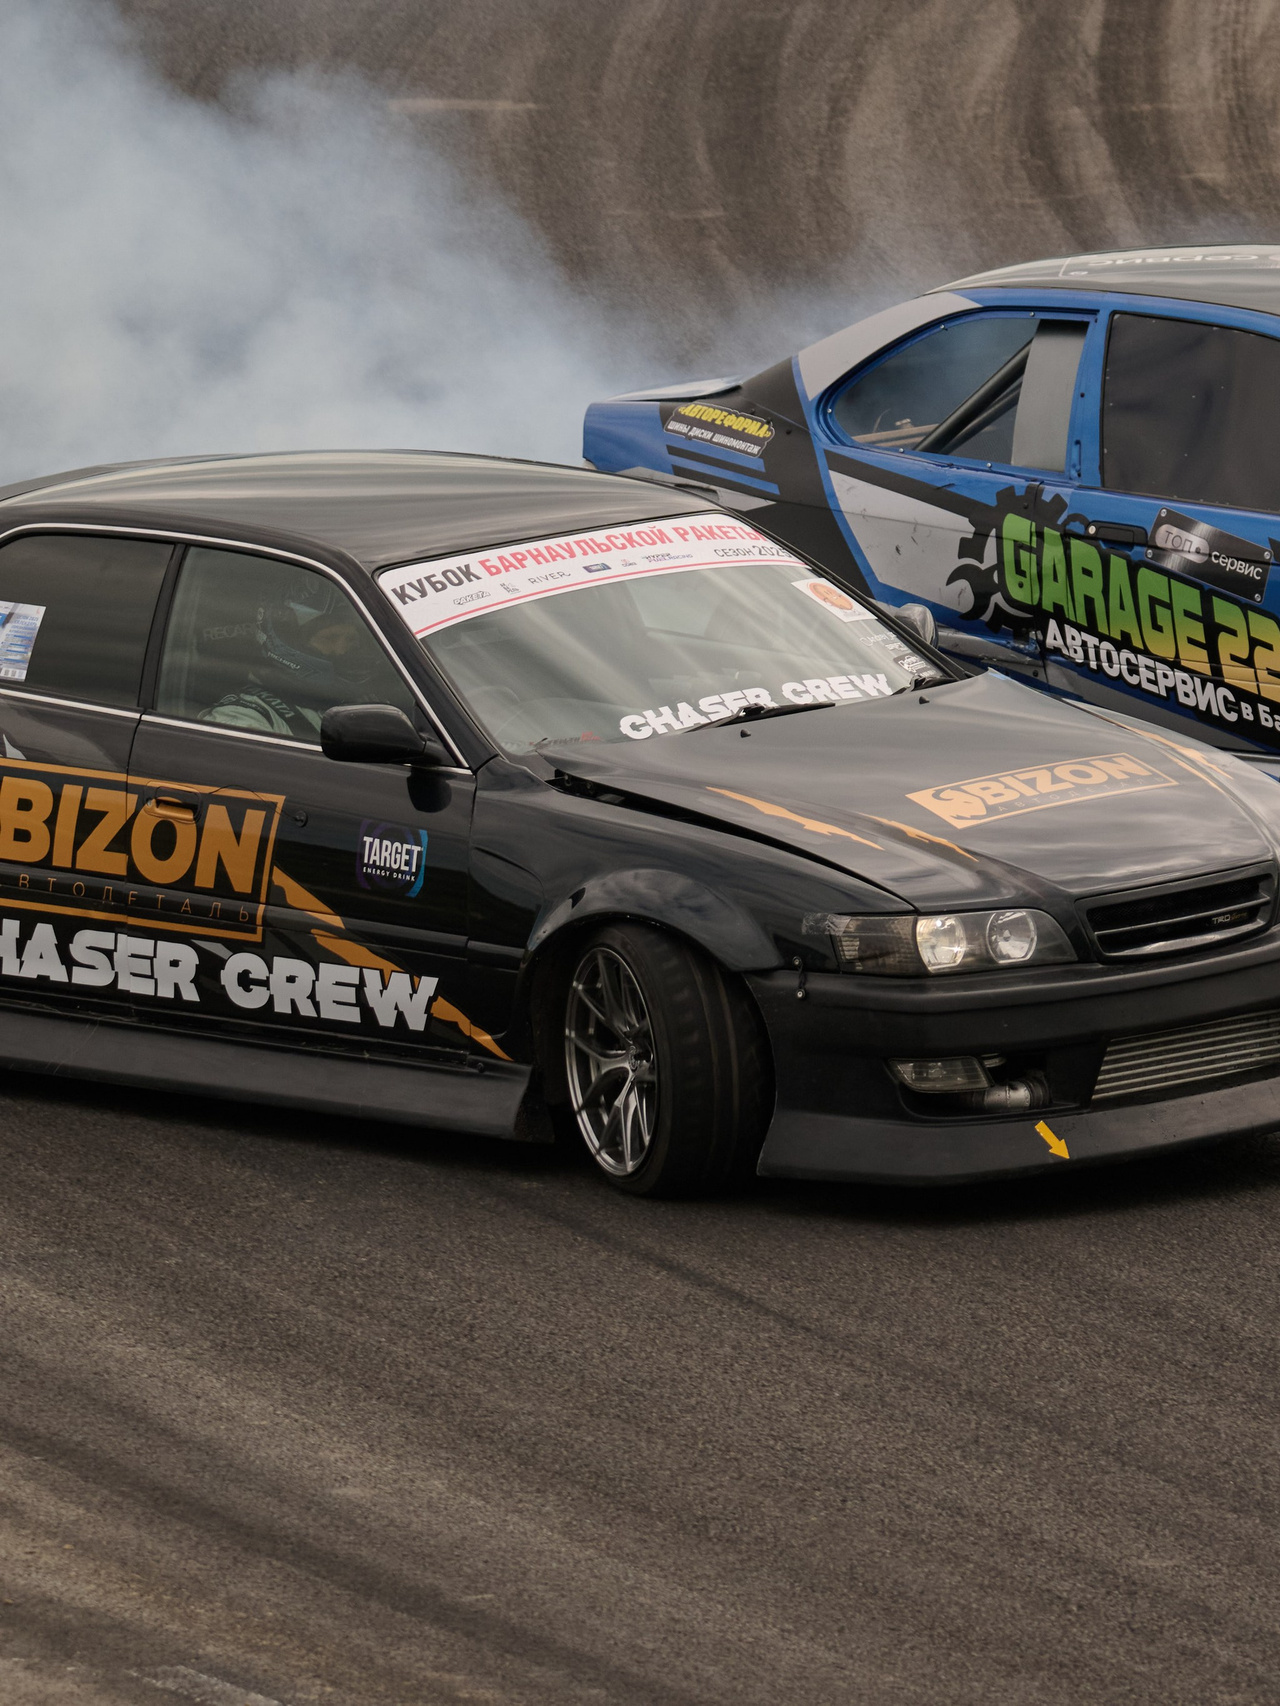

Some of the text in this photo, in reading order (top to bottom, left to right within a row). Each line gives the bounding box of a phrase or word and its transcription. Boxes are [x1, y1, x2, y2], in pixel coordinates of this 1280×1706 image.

[391, 525, 769, 606] КУБОК БАРНАУЛЬСКОЙ РАКЕТЫ
[713, 545, 792, 559] СЕЗОН 2025
[1164, 529, 1263, 580] ТОП сервис
[528, 571, 571, 585] RIVER
[1003, 512, 1211, 677] GARAGE
[203, 622, 258, 640] RECAR
[1045, 618, 1239, 722] АВТОСЕРВИС
[619, 673, 893, 740] CHASER CREW
[960, 756, 1153, 806] BIZON
[0, 776, 267, 894] BIZON
[363, 836, 421, 873] TARGET
[0, 874, 250, 923] ВТОДЕТАЛЬ
[363, 867, 416, 882] ENERGY DRINK
[220, 953, 439, 1031] CREW
